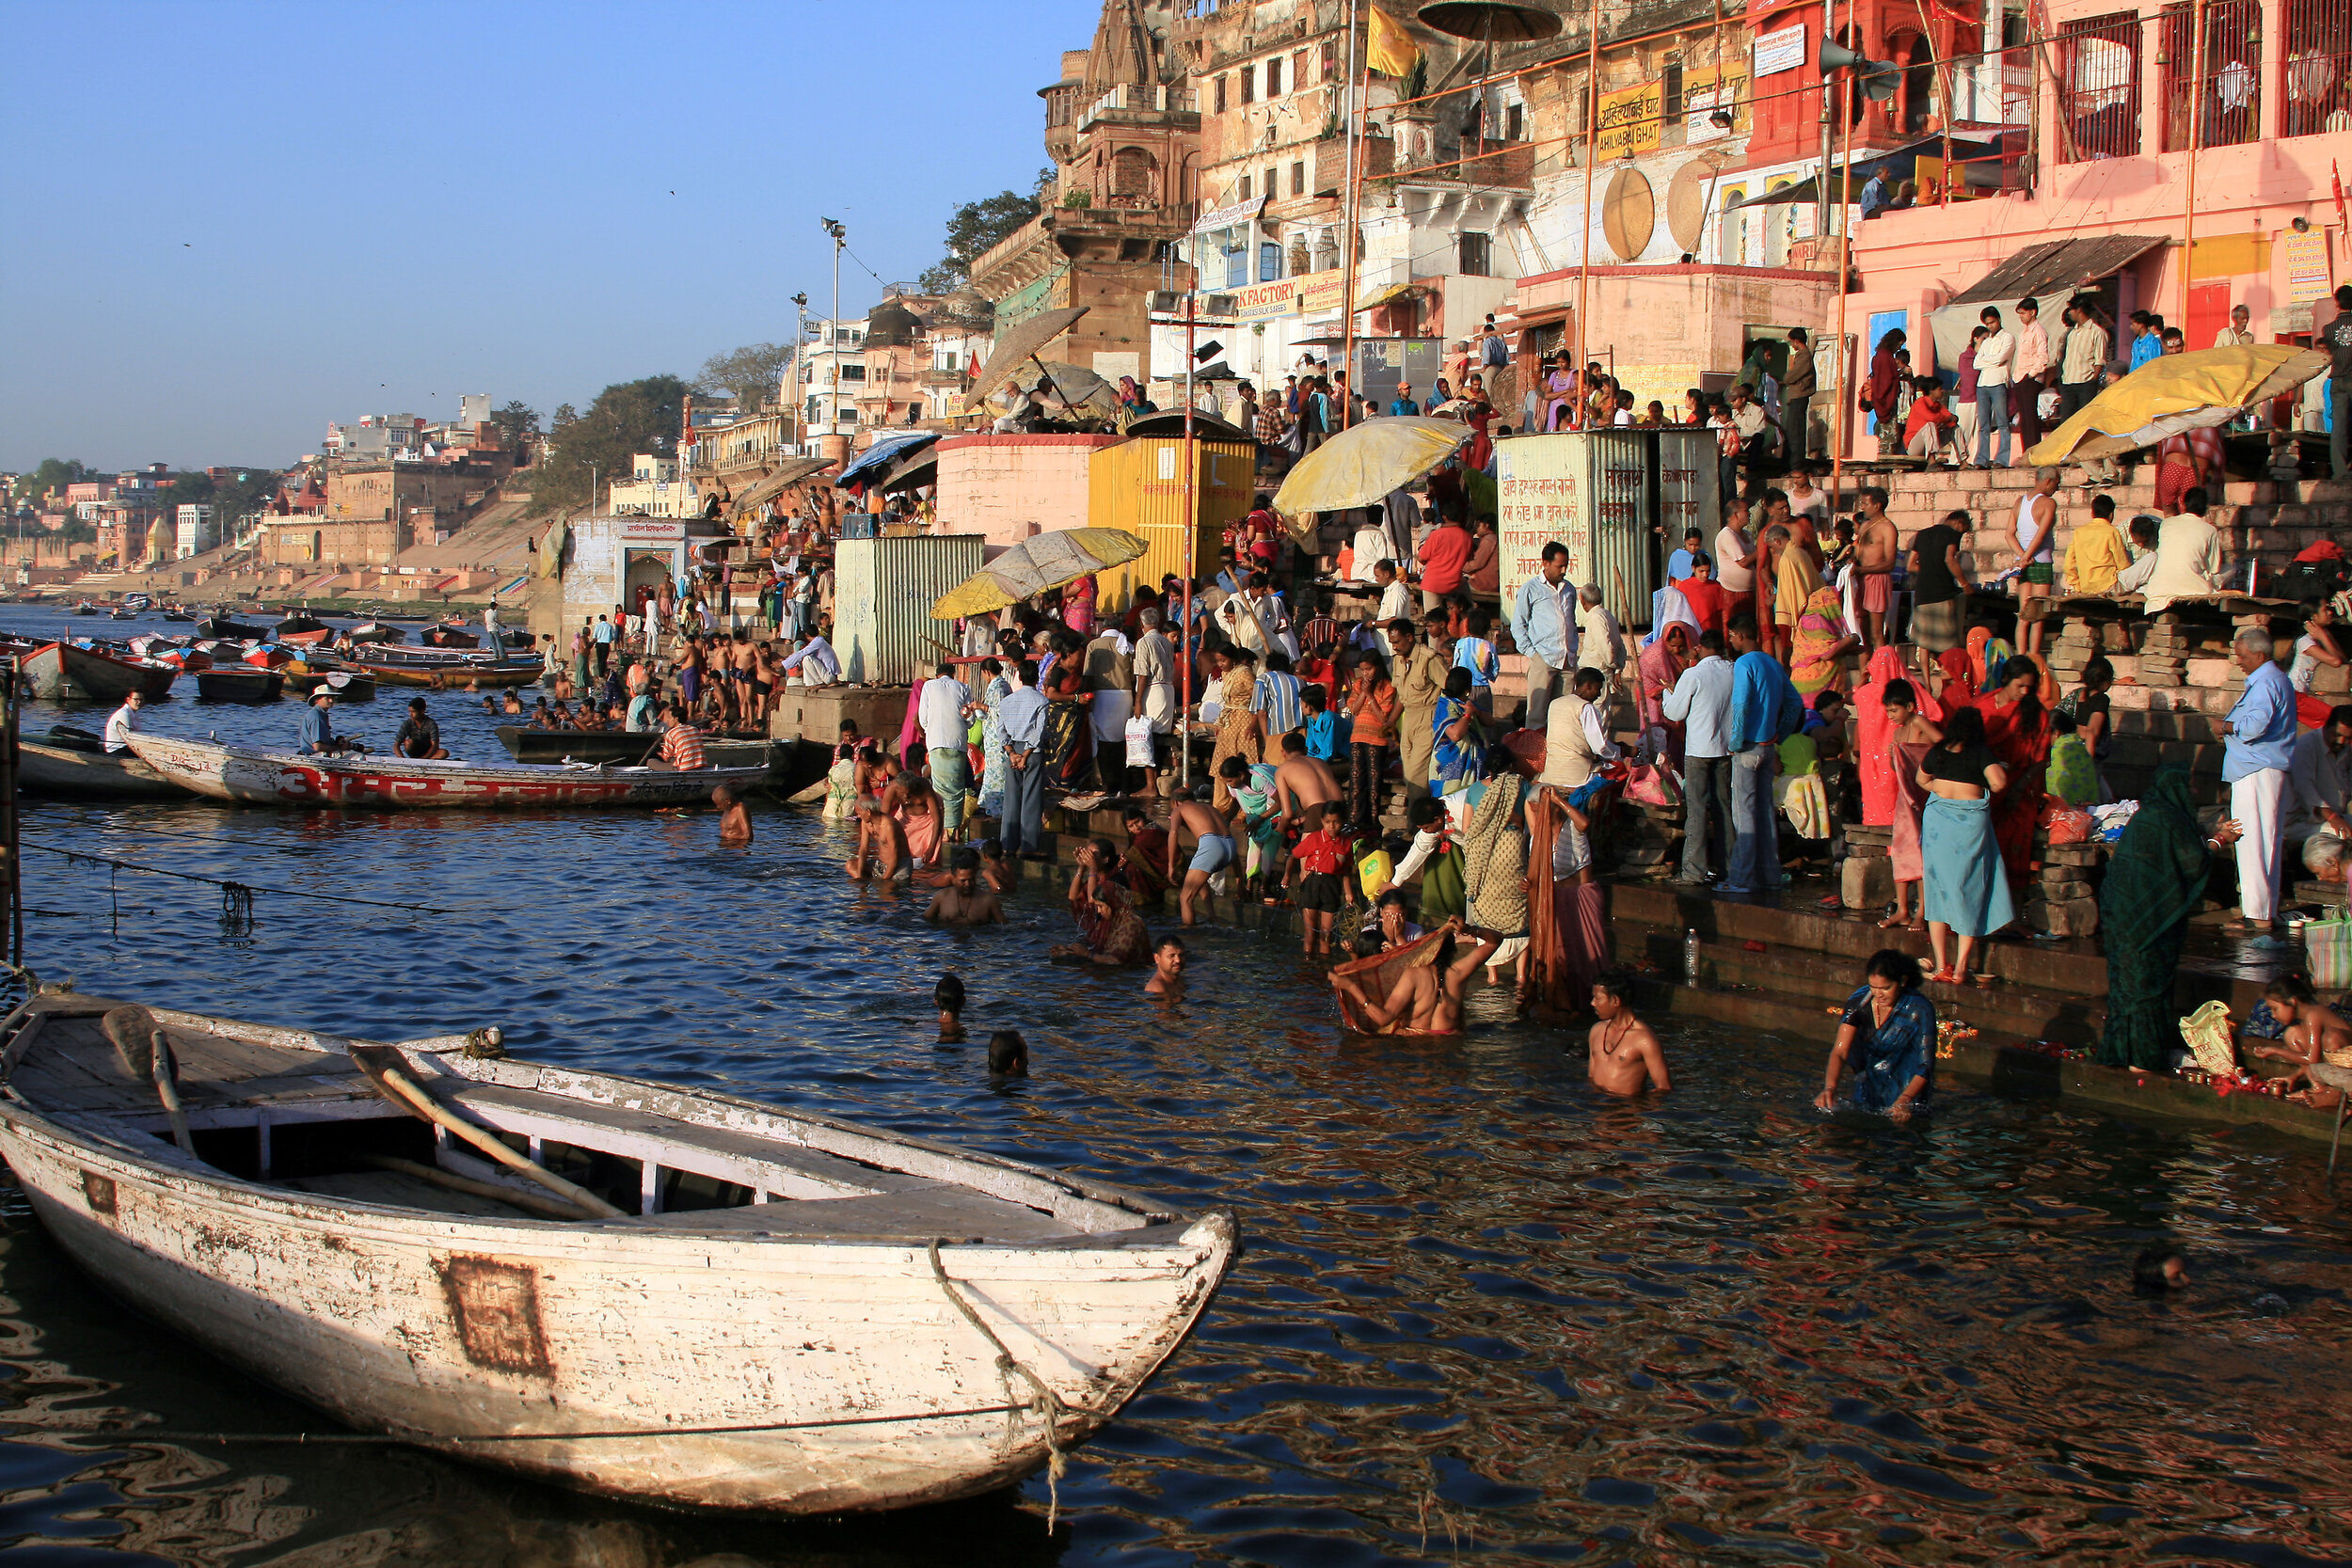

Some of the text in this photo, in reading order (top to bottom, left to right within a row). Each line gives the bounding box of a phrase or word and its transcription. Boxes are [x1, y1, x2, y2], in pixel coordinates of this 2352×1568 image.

[1645, 97, 1659, 114] घाट
[1599, 123, 1659, 152] AHILYABAI GHAT
[1248, 281, 1296, 307] FACTORY
